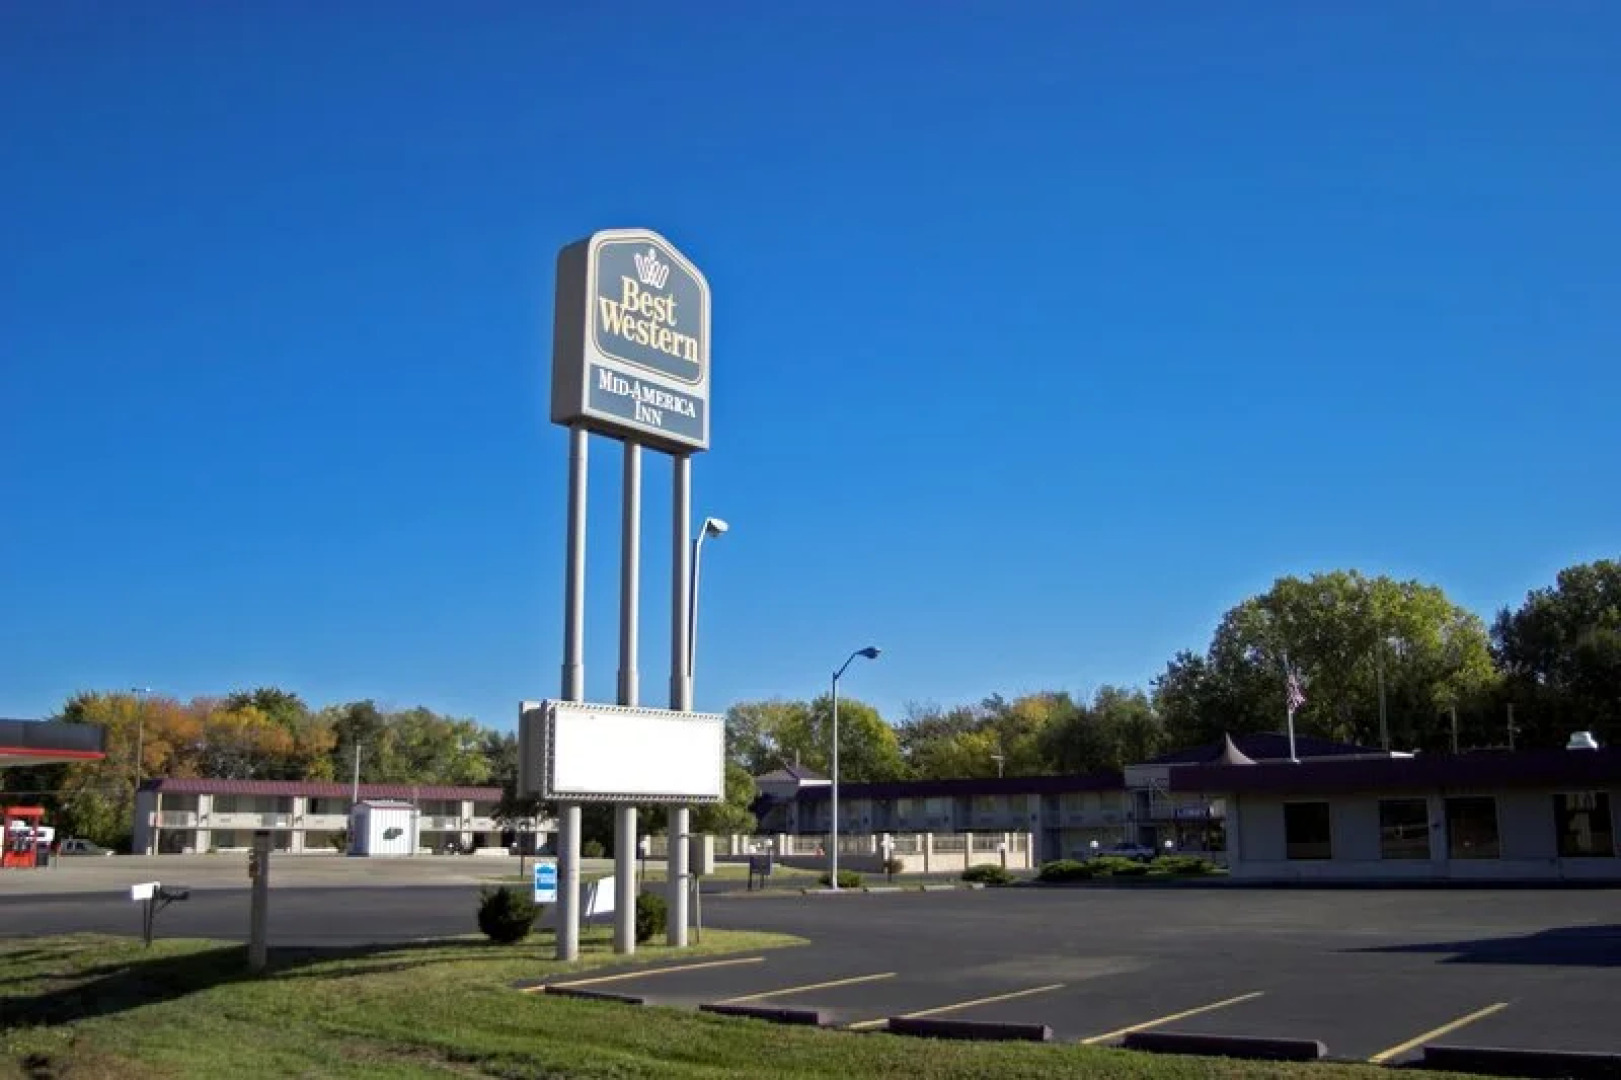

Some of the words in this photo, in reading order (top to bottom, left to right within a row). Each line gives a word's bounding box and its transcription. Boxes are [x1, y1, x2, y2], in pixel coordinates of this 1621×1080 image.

[622, 276, 678, 326] Best
[599, 297, 698, 363] Western
[599, 369, 696, 418] MID-AMERICA
[635, 401, 663, 426] INN
